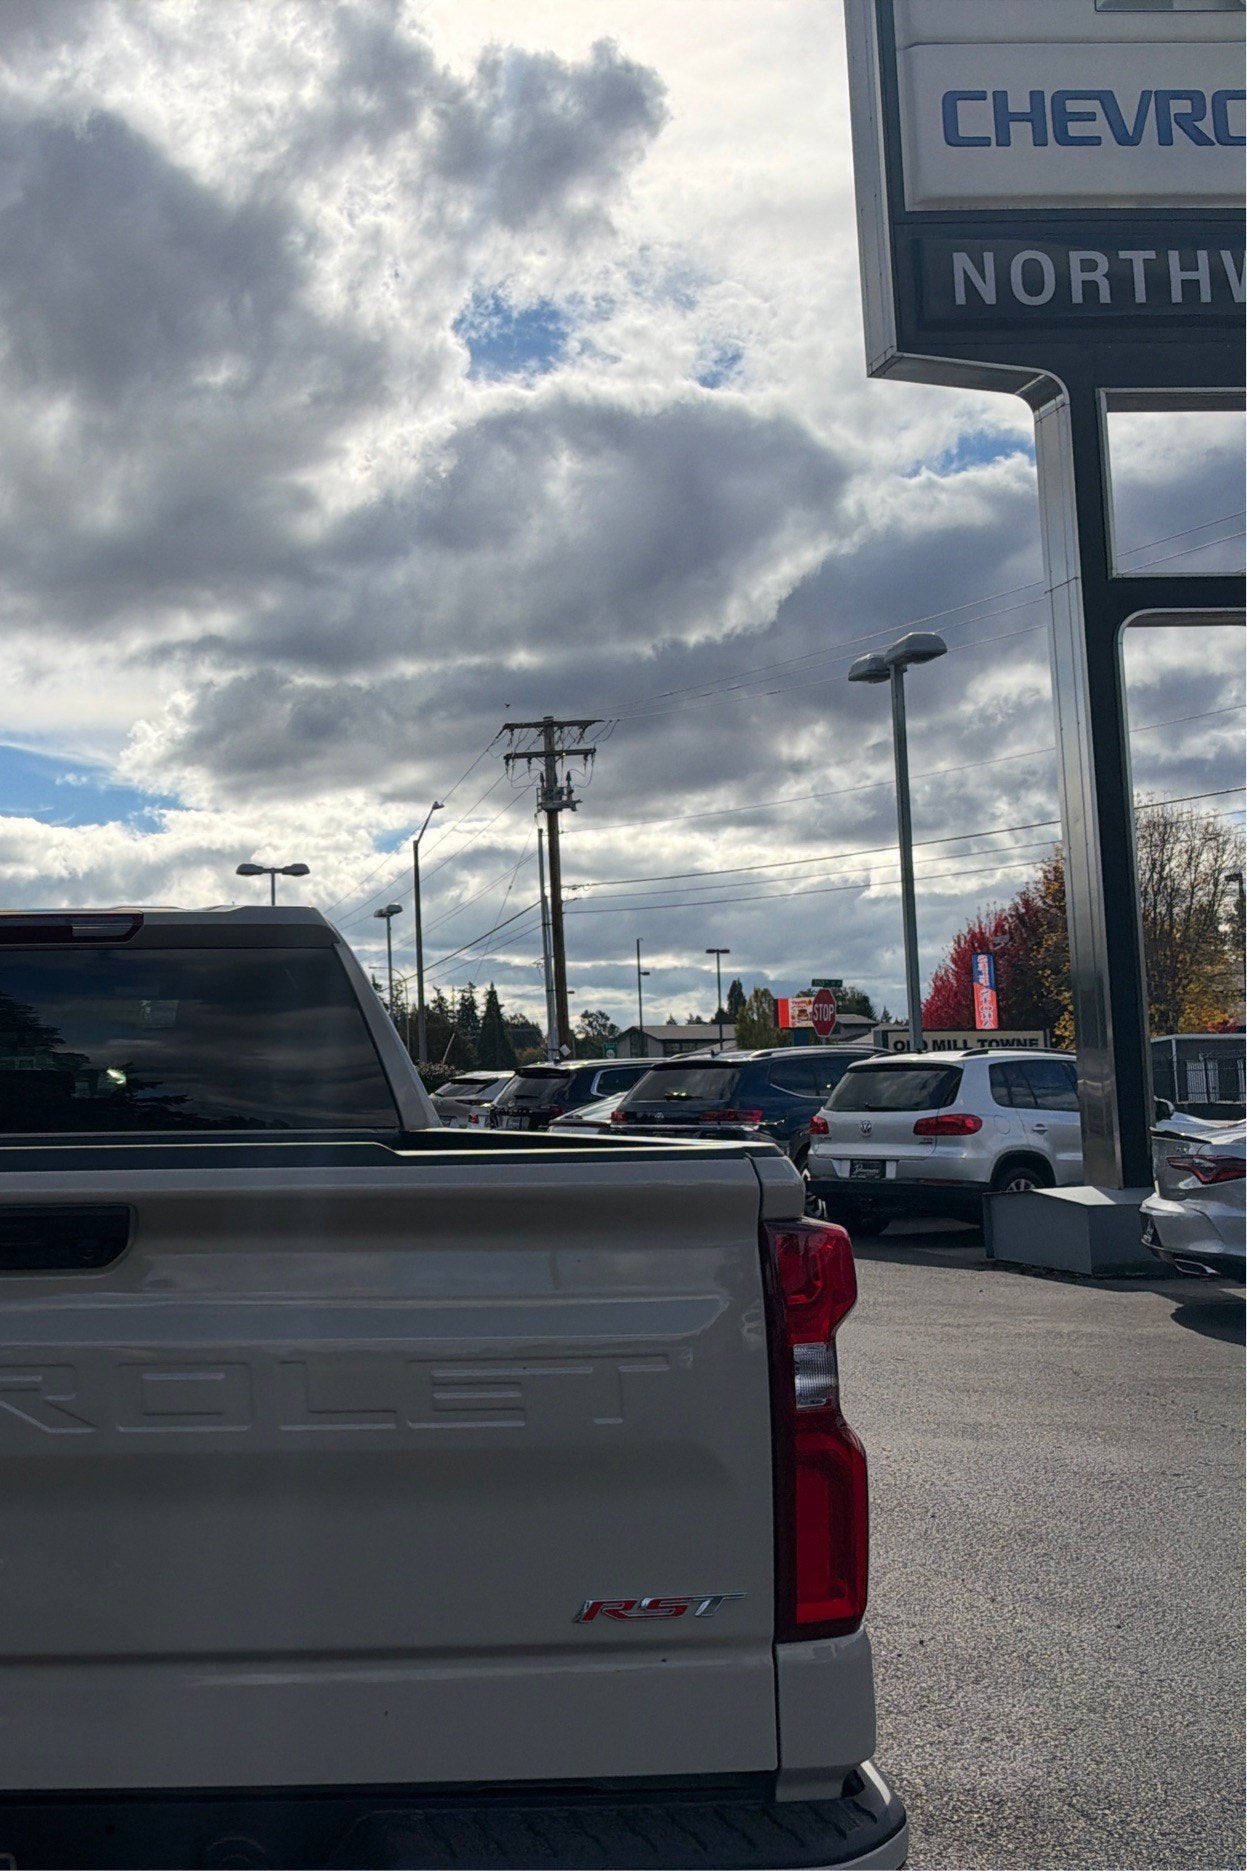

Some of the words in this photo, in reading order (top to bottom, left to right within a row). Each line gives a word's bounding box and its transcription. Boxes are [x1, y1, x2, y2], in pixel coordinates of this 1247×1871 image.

[813, 1003, 834, 1022] STOP
[932, 1039, 972, 1051] MILL
[976, 1039, 1039, 1048] TOWNE
[572, 1592, 748, 1624] RST
